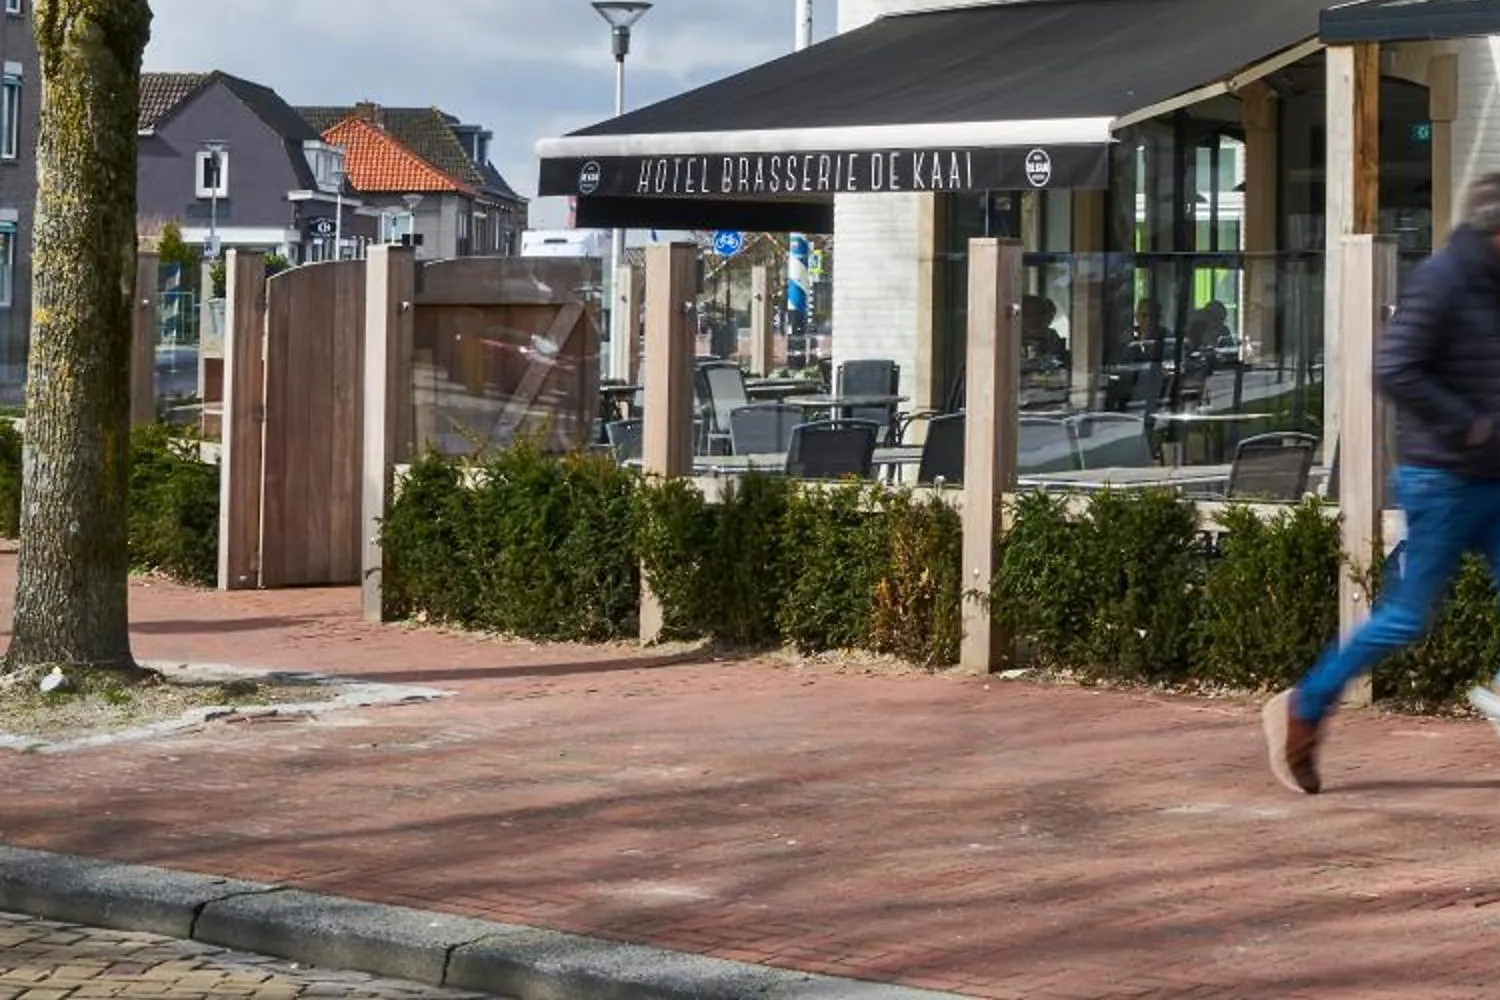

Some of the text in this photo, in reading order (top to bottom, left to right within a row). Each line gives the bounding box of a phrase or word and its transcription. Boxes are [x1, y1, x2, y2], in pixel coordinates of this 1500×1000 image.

[637, 150, 974, 194] HOTEL BRASSERIE DE KAAI
